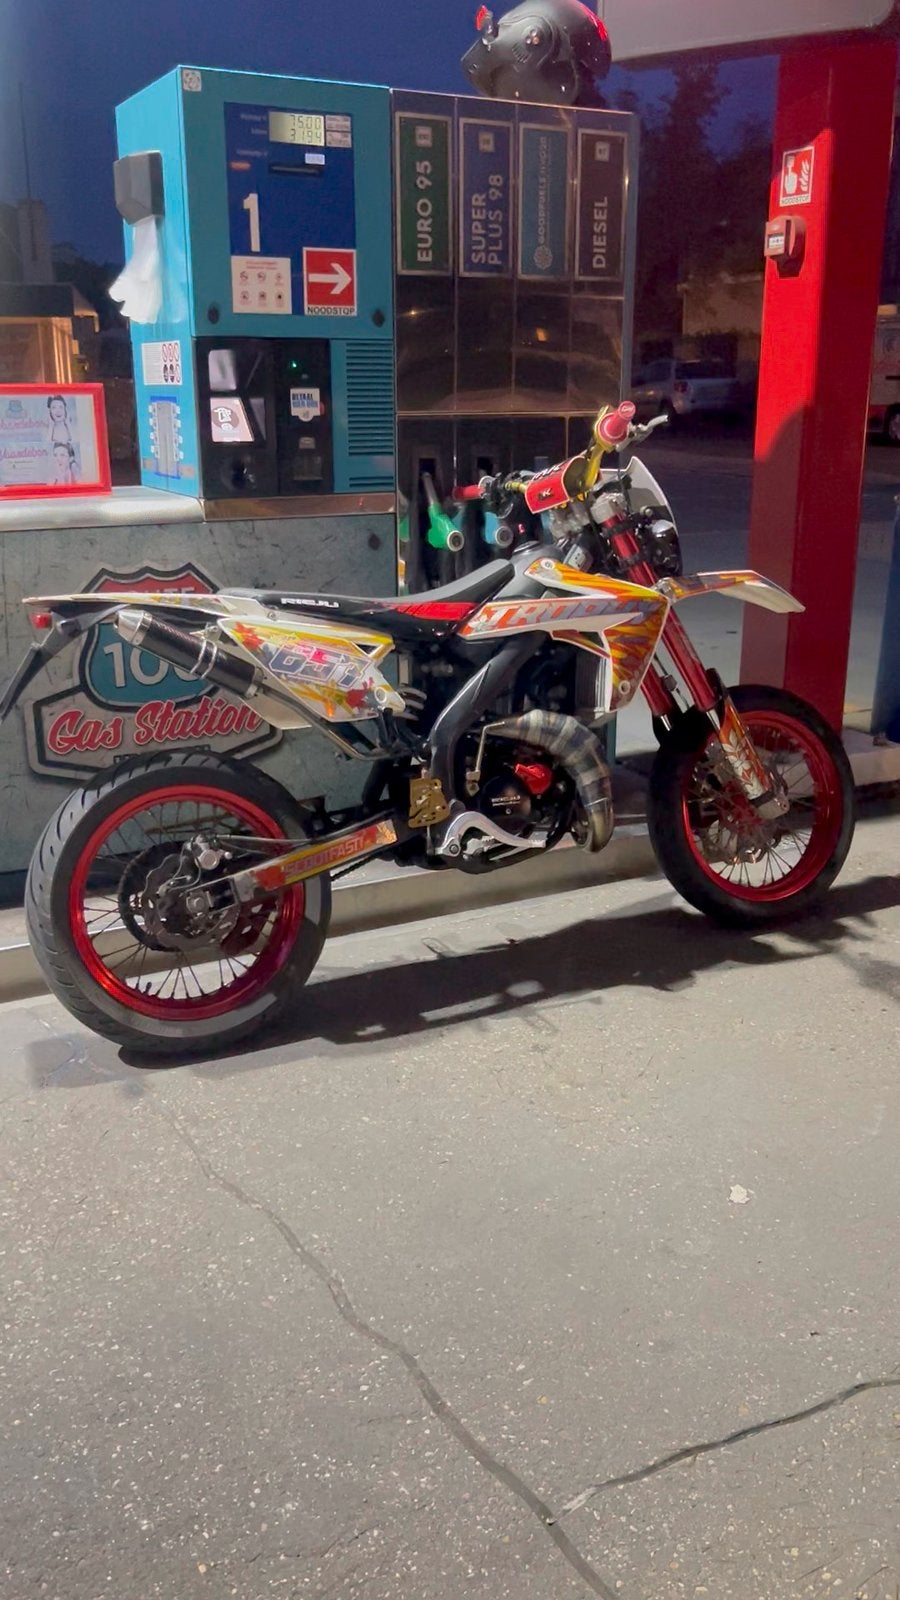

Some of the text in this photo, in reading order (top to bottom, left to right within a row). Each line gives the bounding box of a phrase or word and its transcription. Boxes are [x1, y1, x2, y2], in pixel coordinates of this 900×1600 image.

[416, 160, 432, 190] 95
[243, 193, 260, 252] 1
[417, 198, 432, 262] EURO
[471, 193, 487, 264] SUPER
[488, 174, 503, 265] PLUS 98
[592, 196, 608, 269] DIESEL
[307, 306, 356, 315] NOODSTOP
[48, 695, 262, 754] Gas Station
